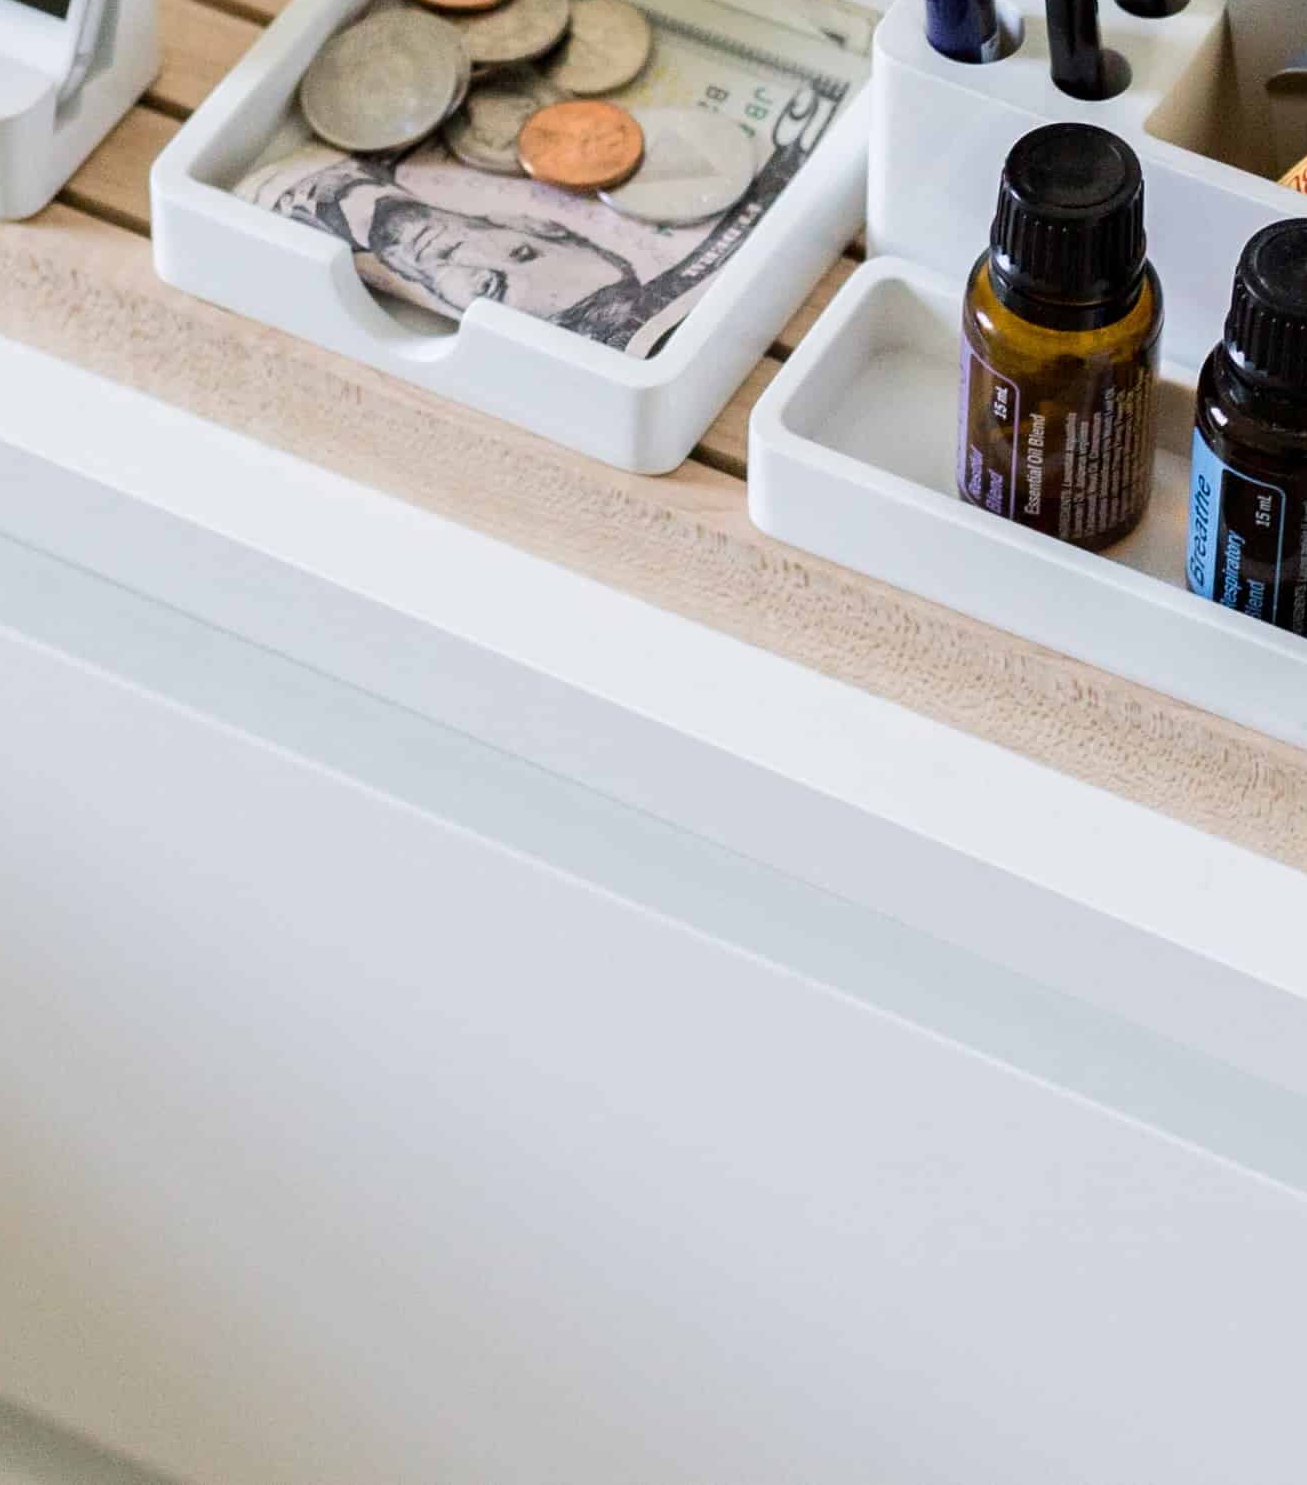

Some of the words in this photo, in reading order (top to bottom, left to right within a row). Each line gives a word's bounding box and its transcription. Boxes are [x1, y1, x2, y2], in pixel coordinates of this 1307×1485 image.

[1029, 413, 1046, 447] Blend
[1027, 450, 1044, 465] Oil
[1024, 465, 1043, 515] Essential
[1190, 474, 1212, 587] Breathe
[1255, 511, 1271, 527] 15
